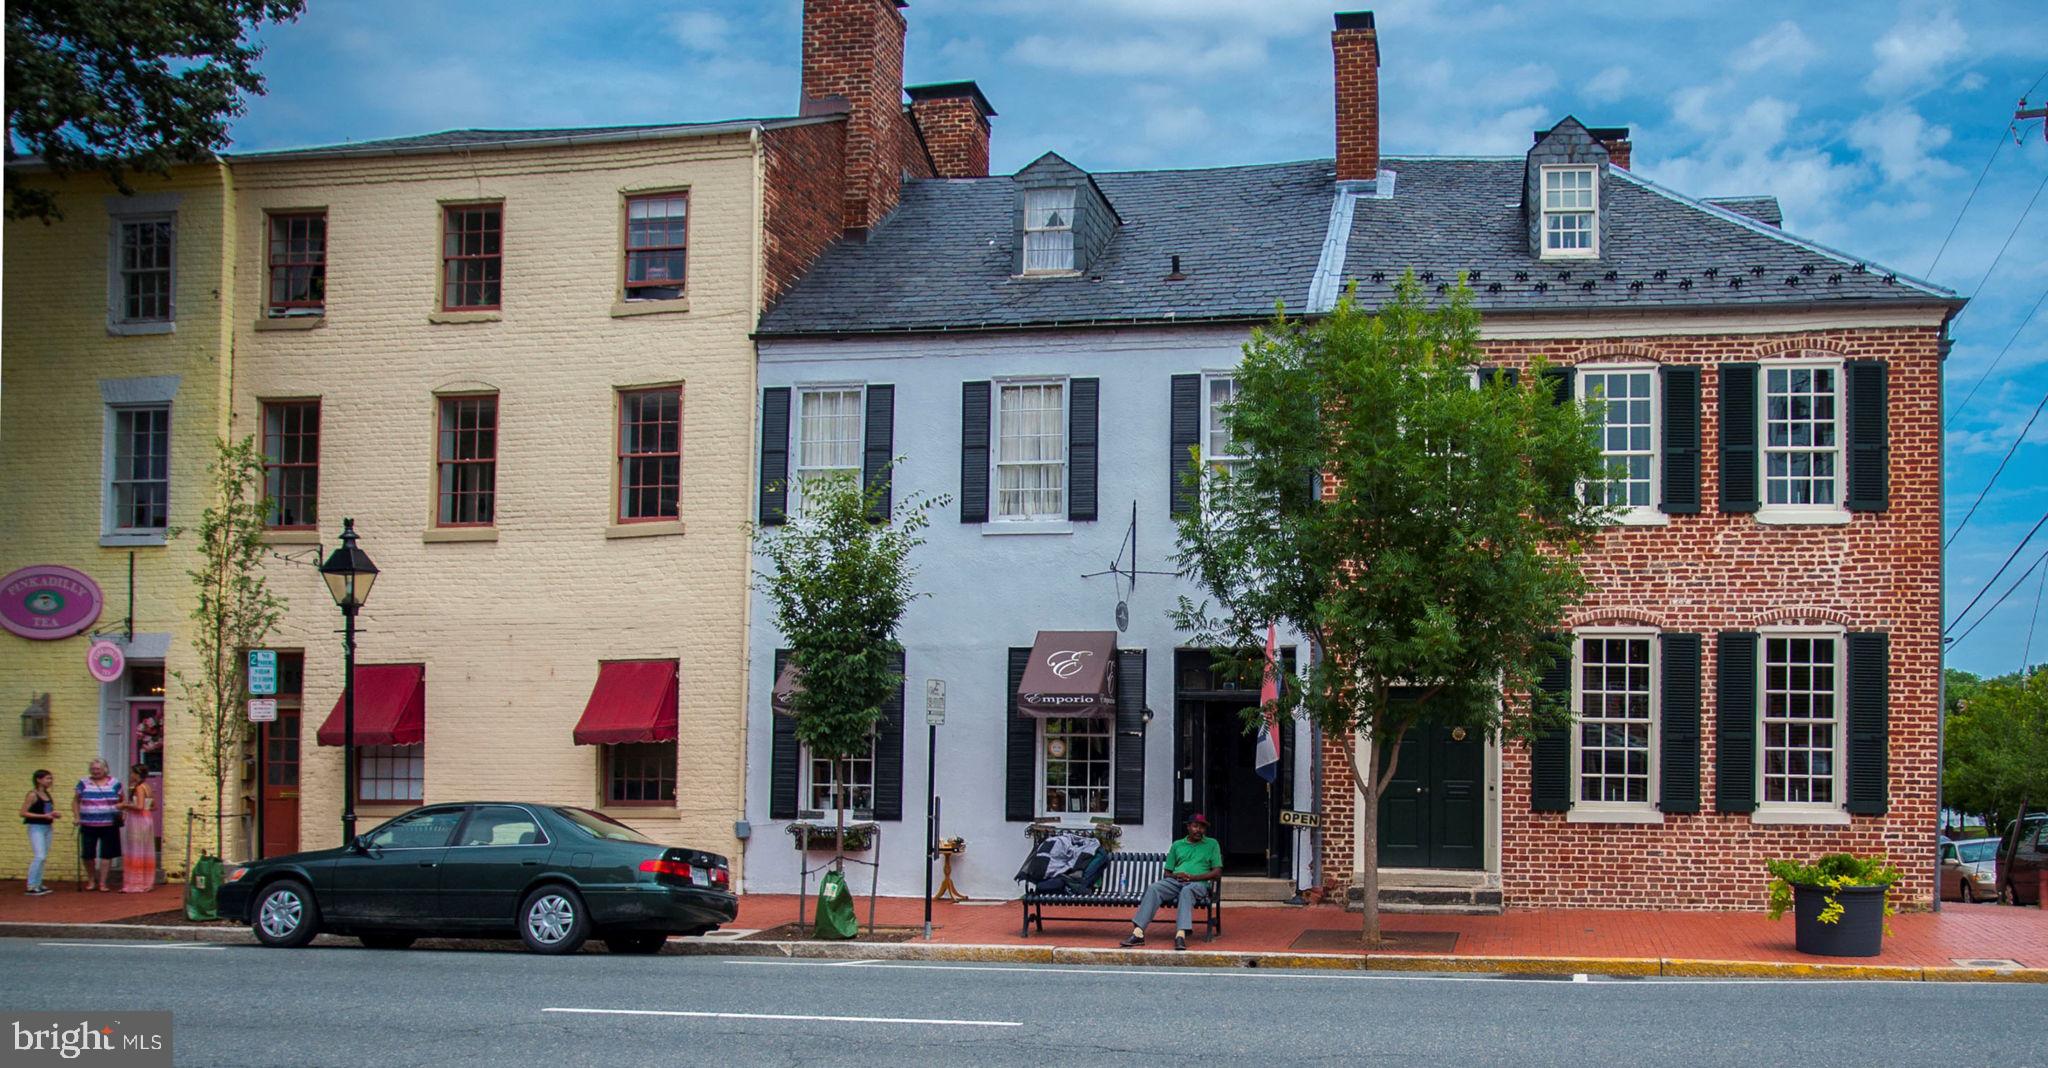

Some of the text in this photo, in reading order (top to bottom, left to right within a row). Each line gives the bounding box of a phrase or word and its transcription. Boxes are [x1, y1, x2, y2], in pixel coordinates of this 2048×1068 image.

[7, 576, 88, 597] PINKADILLY
[32, 617, 59, 627] TEA
[1046, 650, 1094, 679] E
[1023, 691, 1094, 705] Emporio
[1282, 812, 1318, 826] OPEN
